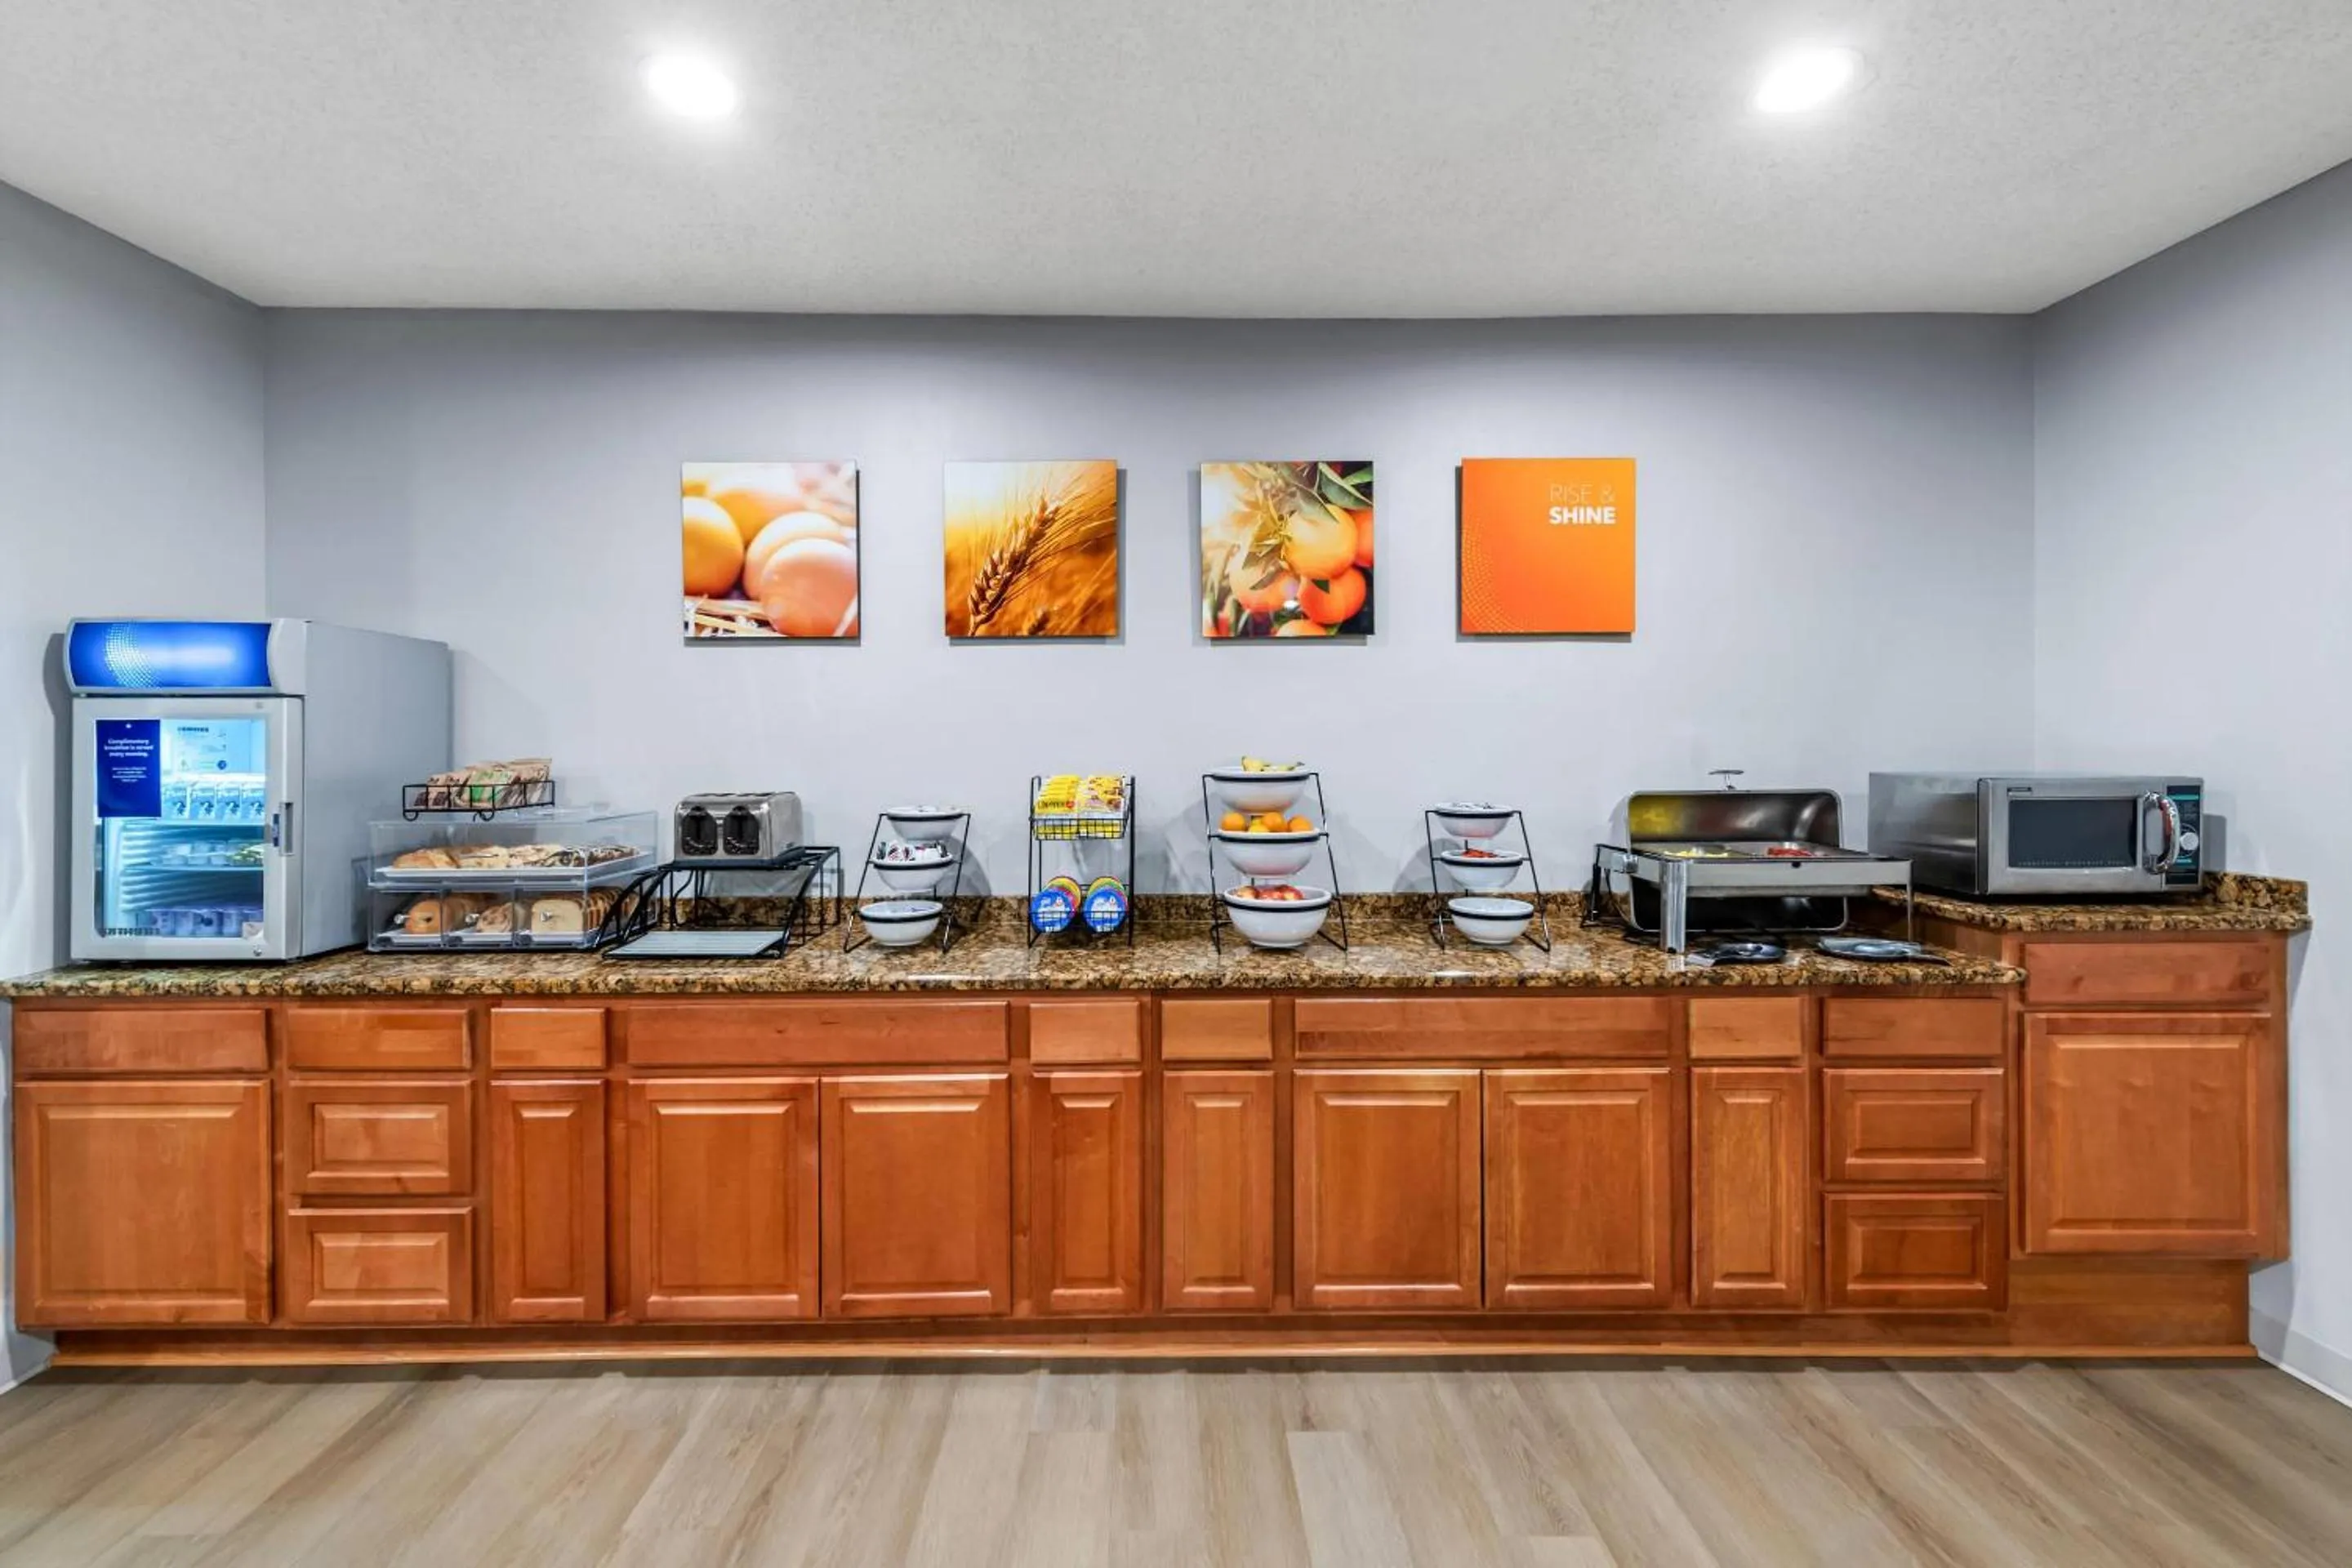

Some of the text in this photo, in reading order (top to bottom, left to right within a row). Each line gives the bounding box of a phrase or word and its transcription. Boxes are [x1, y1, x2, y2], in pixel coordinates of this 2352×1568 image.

[1549, 483, 1616, 504] RISE &
[1548, 506, 1617, 524] SHINE
